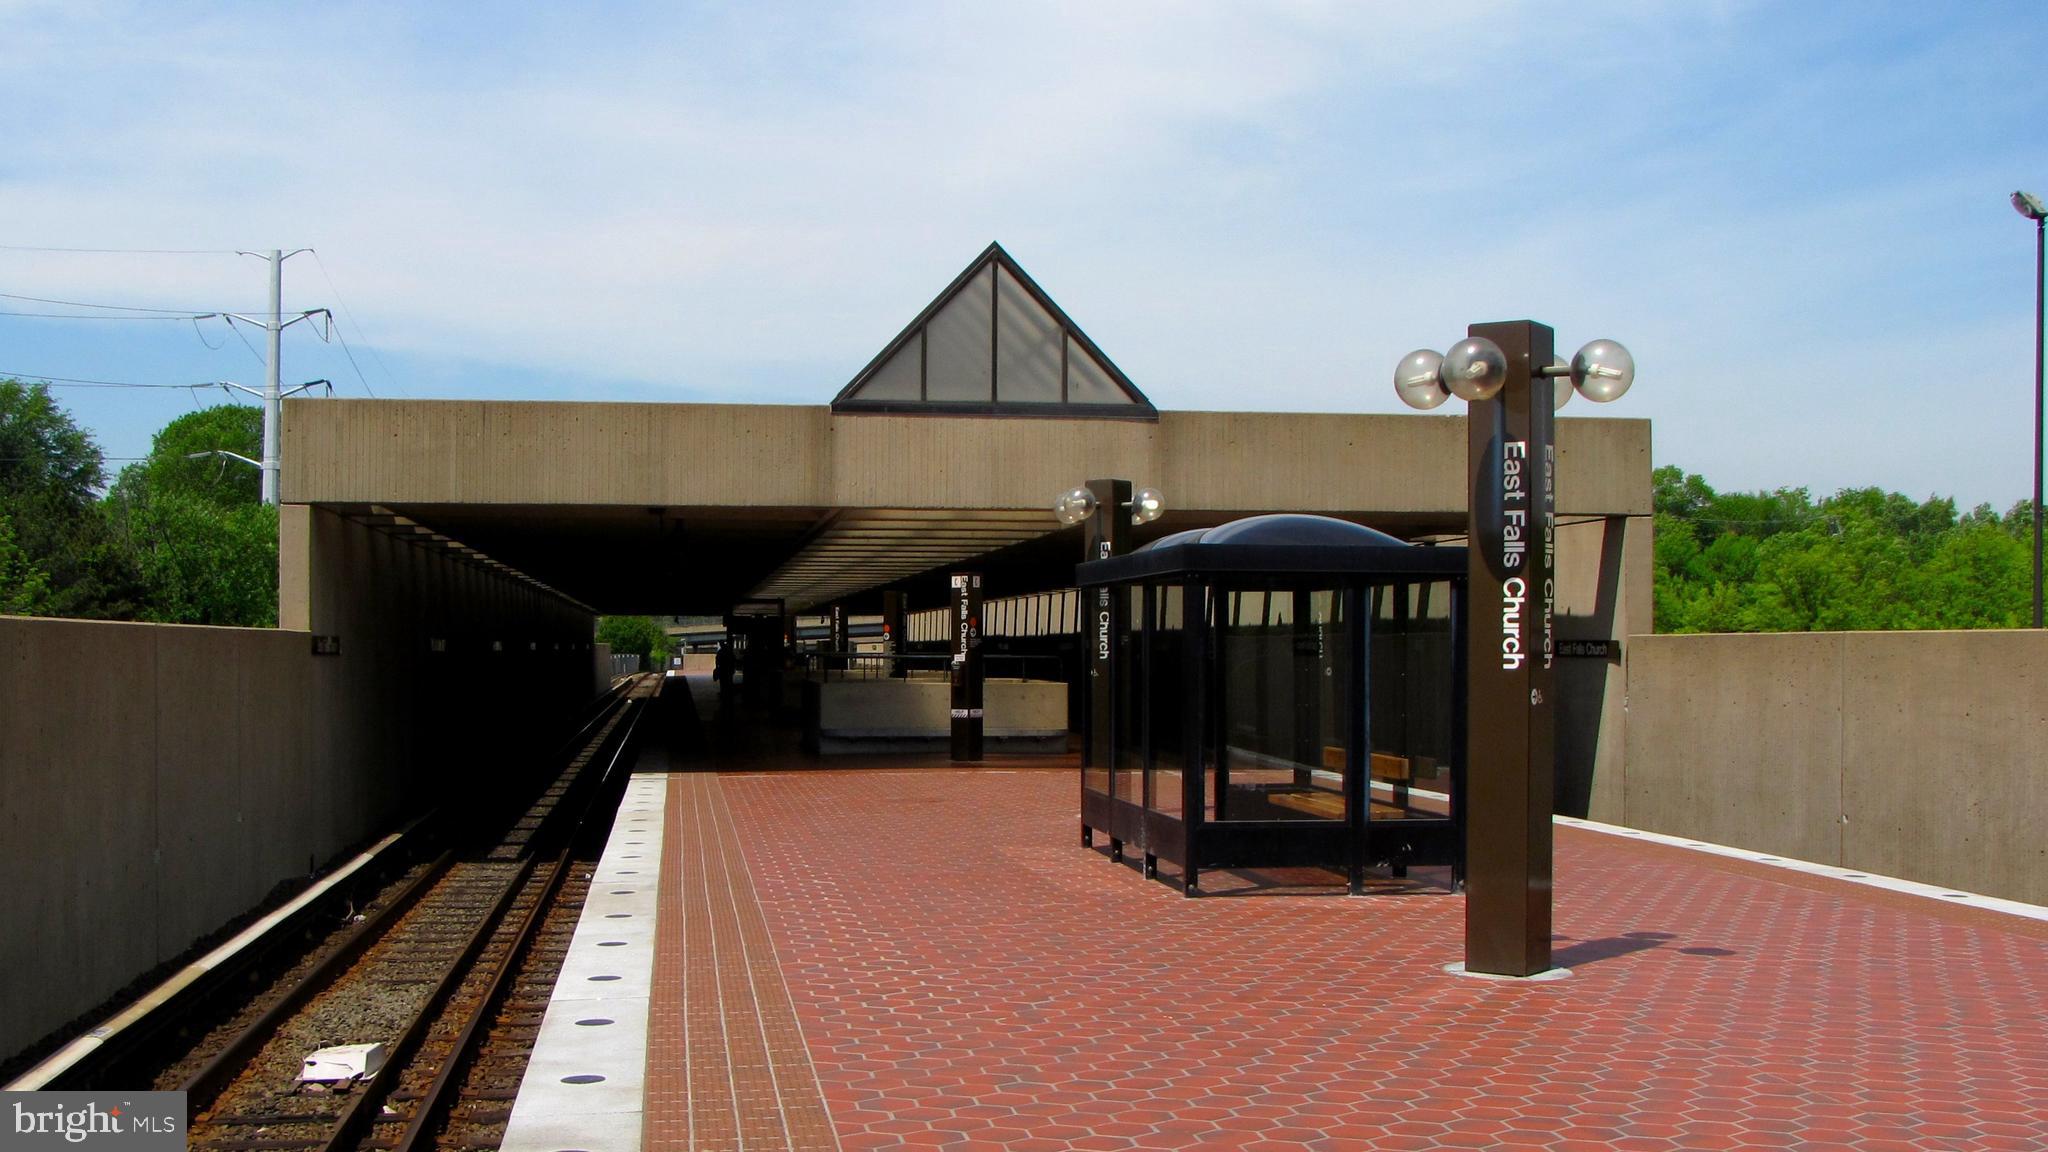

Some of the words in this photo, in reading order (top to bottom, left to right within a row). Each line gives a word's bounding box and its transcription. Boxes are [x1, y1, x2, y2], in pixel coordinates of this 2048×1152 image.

[1503, 441, 1526, 501] East
[1544, 444, 1555, 503] East
[1100, 541, 1111, 560] Ea
[1503, 511, 1526, 568] Falls
[1544, 512, 1555, 569] Falls
[961, 599, 969, 620] Falls
[1099, 586, 1110, 607] alls
[961, 622, 970, 657] Church
[1099, 611, 1110, 660] Church
[1502, 576, 1526, 671] Church
[1543, 578, 1555, 671] Church
[1586, 642, 1608, 656] Church
